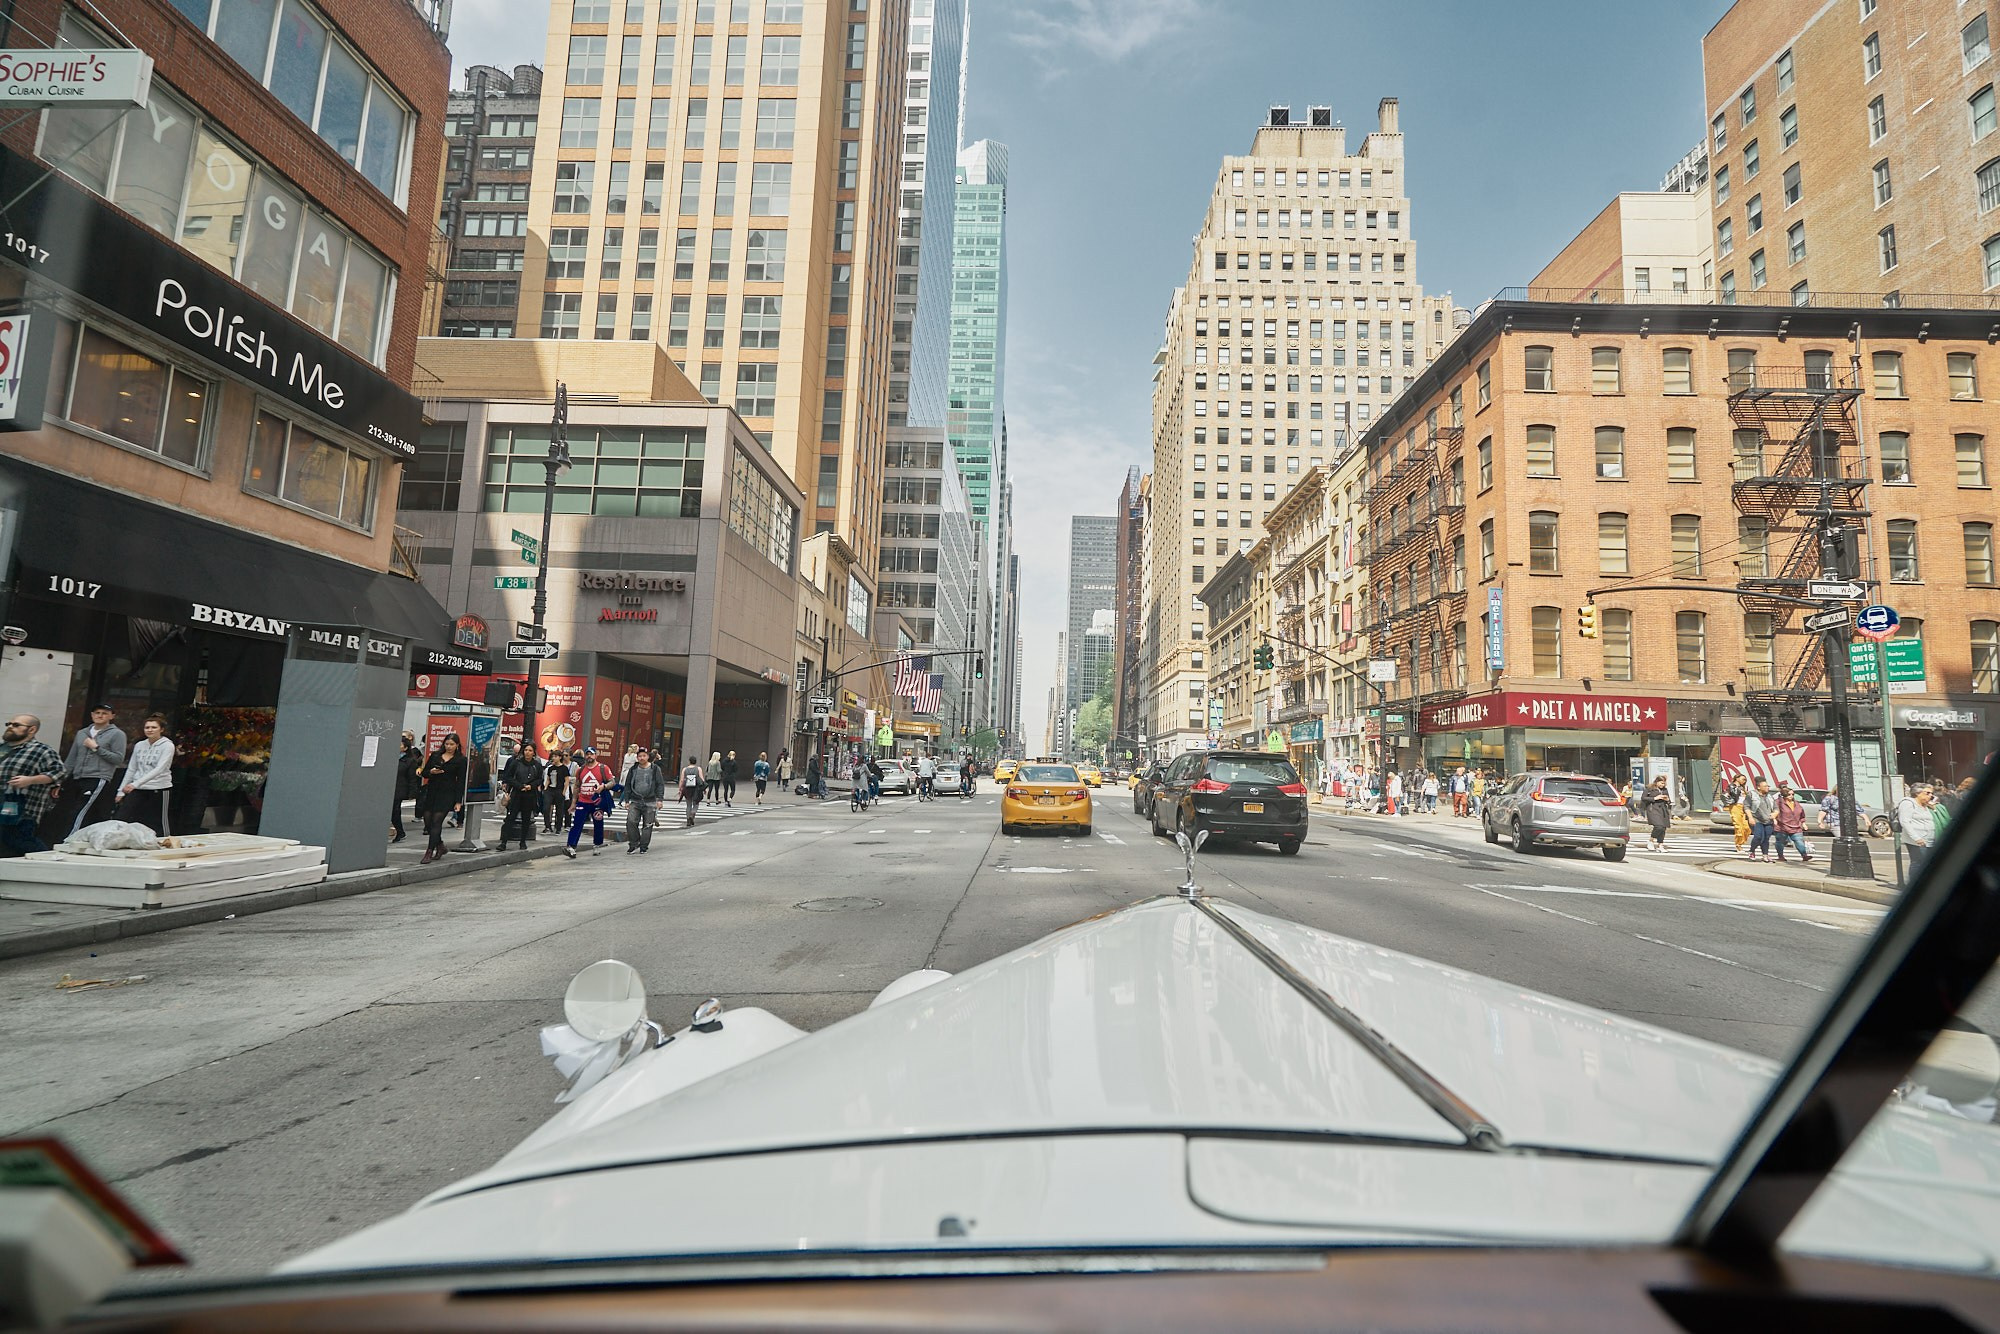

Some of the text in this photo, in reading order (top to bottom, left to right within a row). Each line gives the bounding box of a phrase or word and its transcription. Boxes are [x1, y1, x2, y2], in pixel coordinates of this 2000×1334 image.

[8, 85, 85, 96] CUBAN CUISINE
[5, 232, 50, 264] 1017
[156, 278, 344, 409] Polish Me
[368, 424, 415, 455] 212-391-7409
[524, 551, 530, 560] 6
[48, 576, 102, 599] 1017
[496, 578, 504, 588] W
[507, 578, 518, 588] 38
[578, 572, 686, 592] Residence
[619, 594, 643, 605] Inn
[598, 608, 658, 622] Marriott
[1829, 613, 1843, 622] WAY
[456, 616, 485, 635] BRYANT
[520, 626, 530, 636] ONE
[457, 628, 482, 647] DELI
[512, 646, 527, 654] ONE
[1850, 644, 1874, 652] QM15
[428, 652, 483, 672] 212-730-2345
[1852, 654, 1875, 662] QM16
[1852, 663, 1876, 672] QM17
[1854, 673, 1877, 681] QM18
[743, 698, 768, 708] BANK
[1438, 707, 1450, 726] PRET
[1457, 703, 1482, 724] MANGER
[1532, 700, 1641, 723] PRET A MANGER
